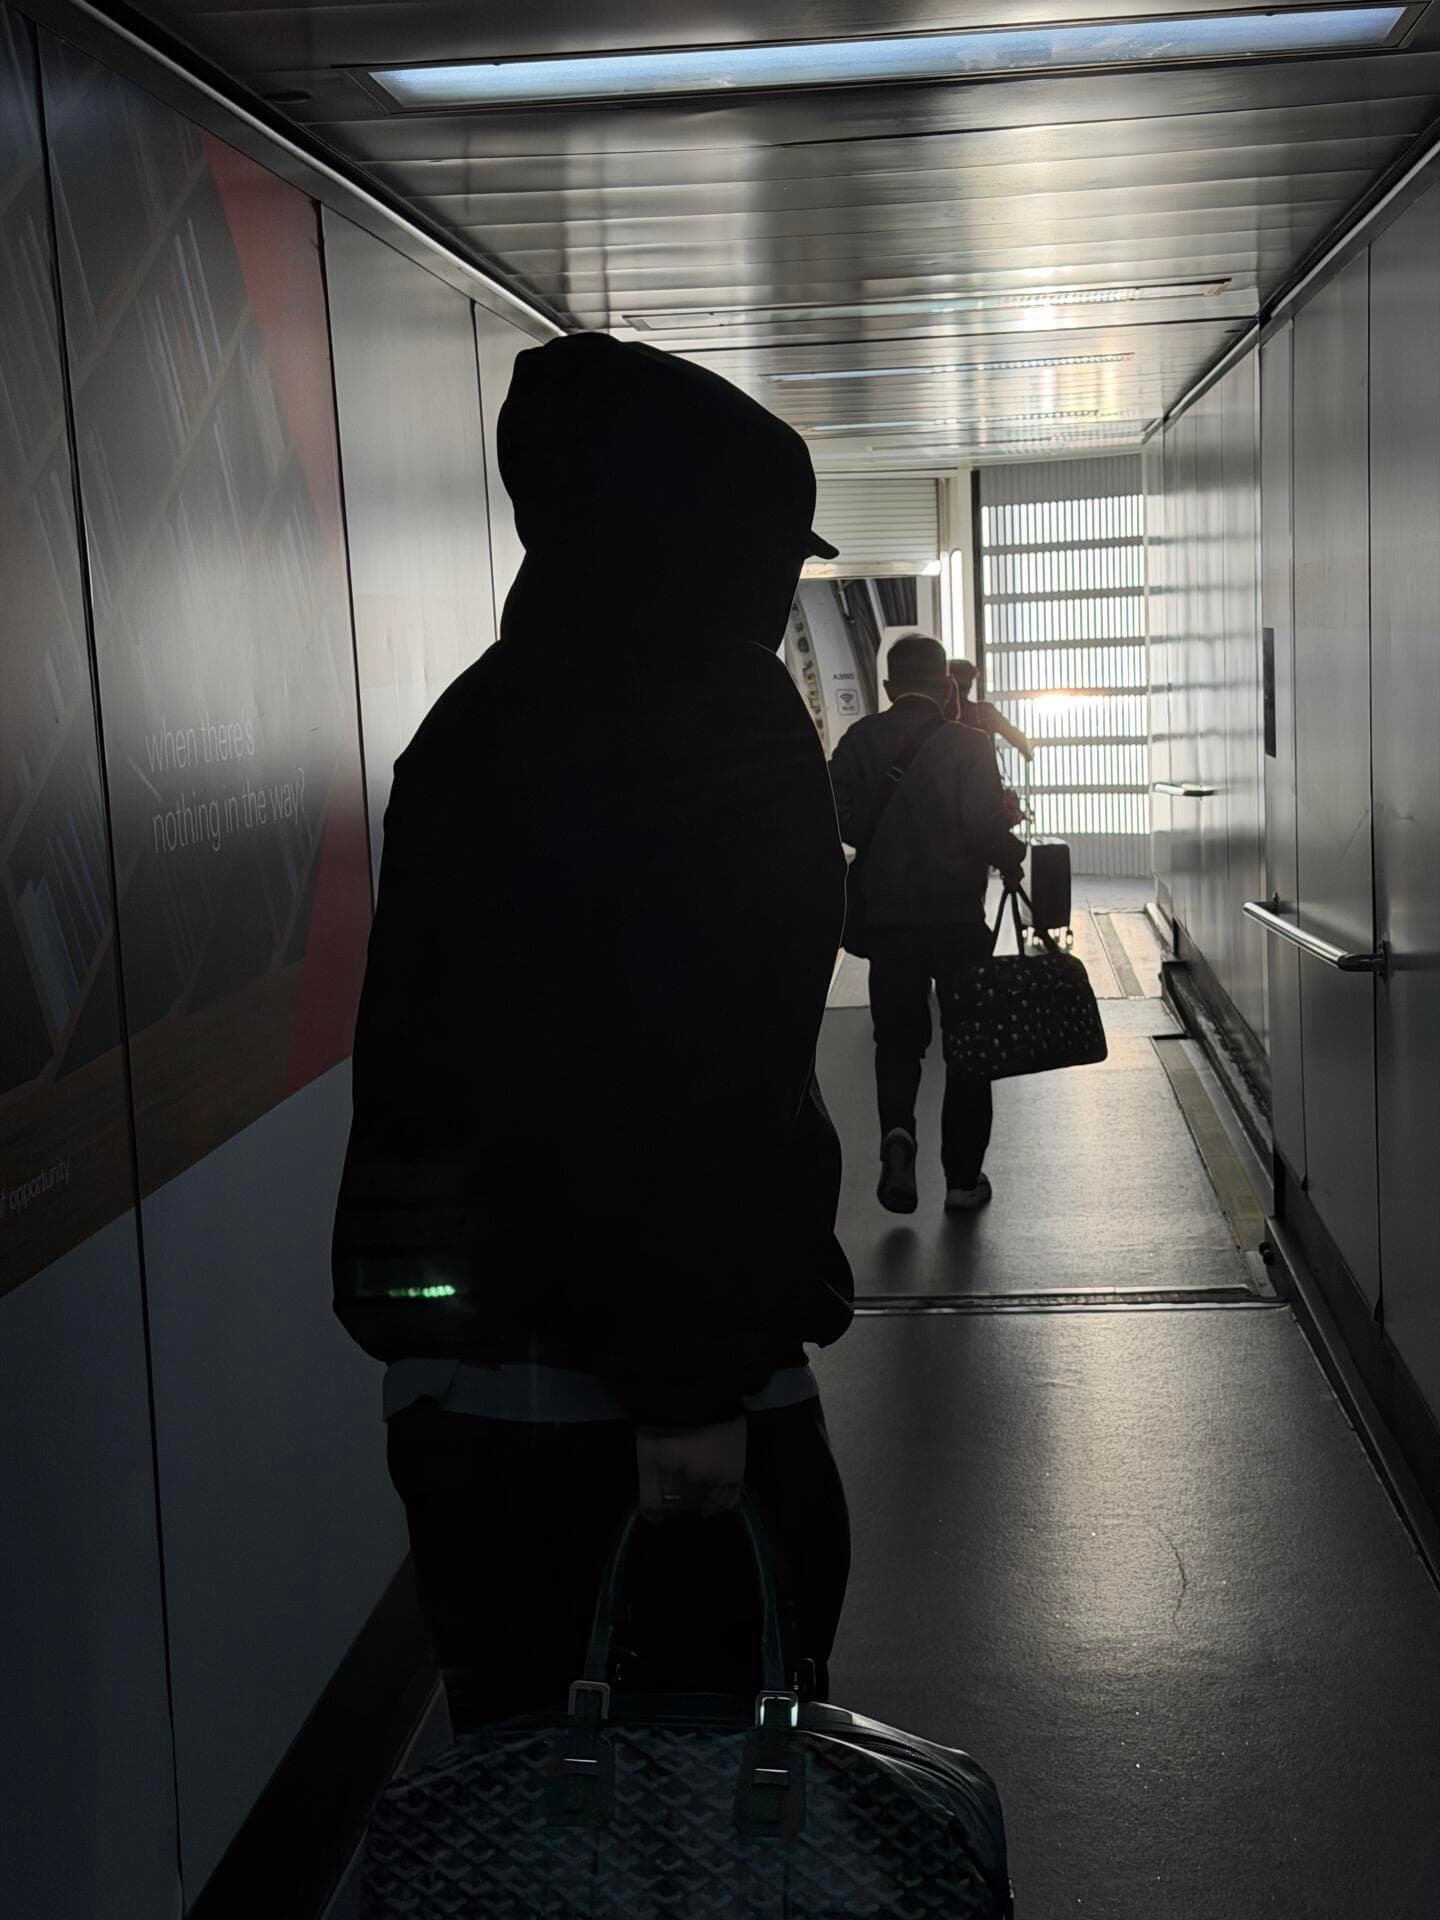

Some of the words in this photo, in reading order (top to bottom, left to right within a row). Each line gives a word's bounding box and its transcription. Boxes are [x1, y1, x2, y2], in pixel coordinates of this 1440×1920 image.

[200, 706, 257, 763] there's
[152, 788, 221, 854] nothing
[224, 782, 240, 834] in
[241, 777, 268, 829] the
[268, 766, 305, 826] way?
[9, 1152, 71, 1214] opportunity
